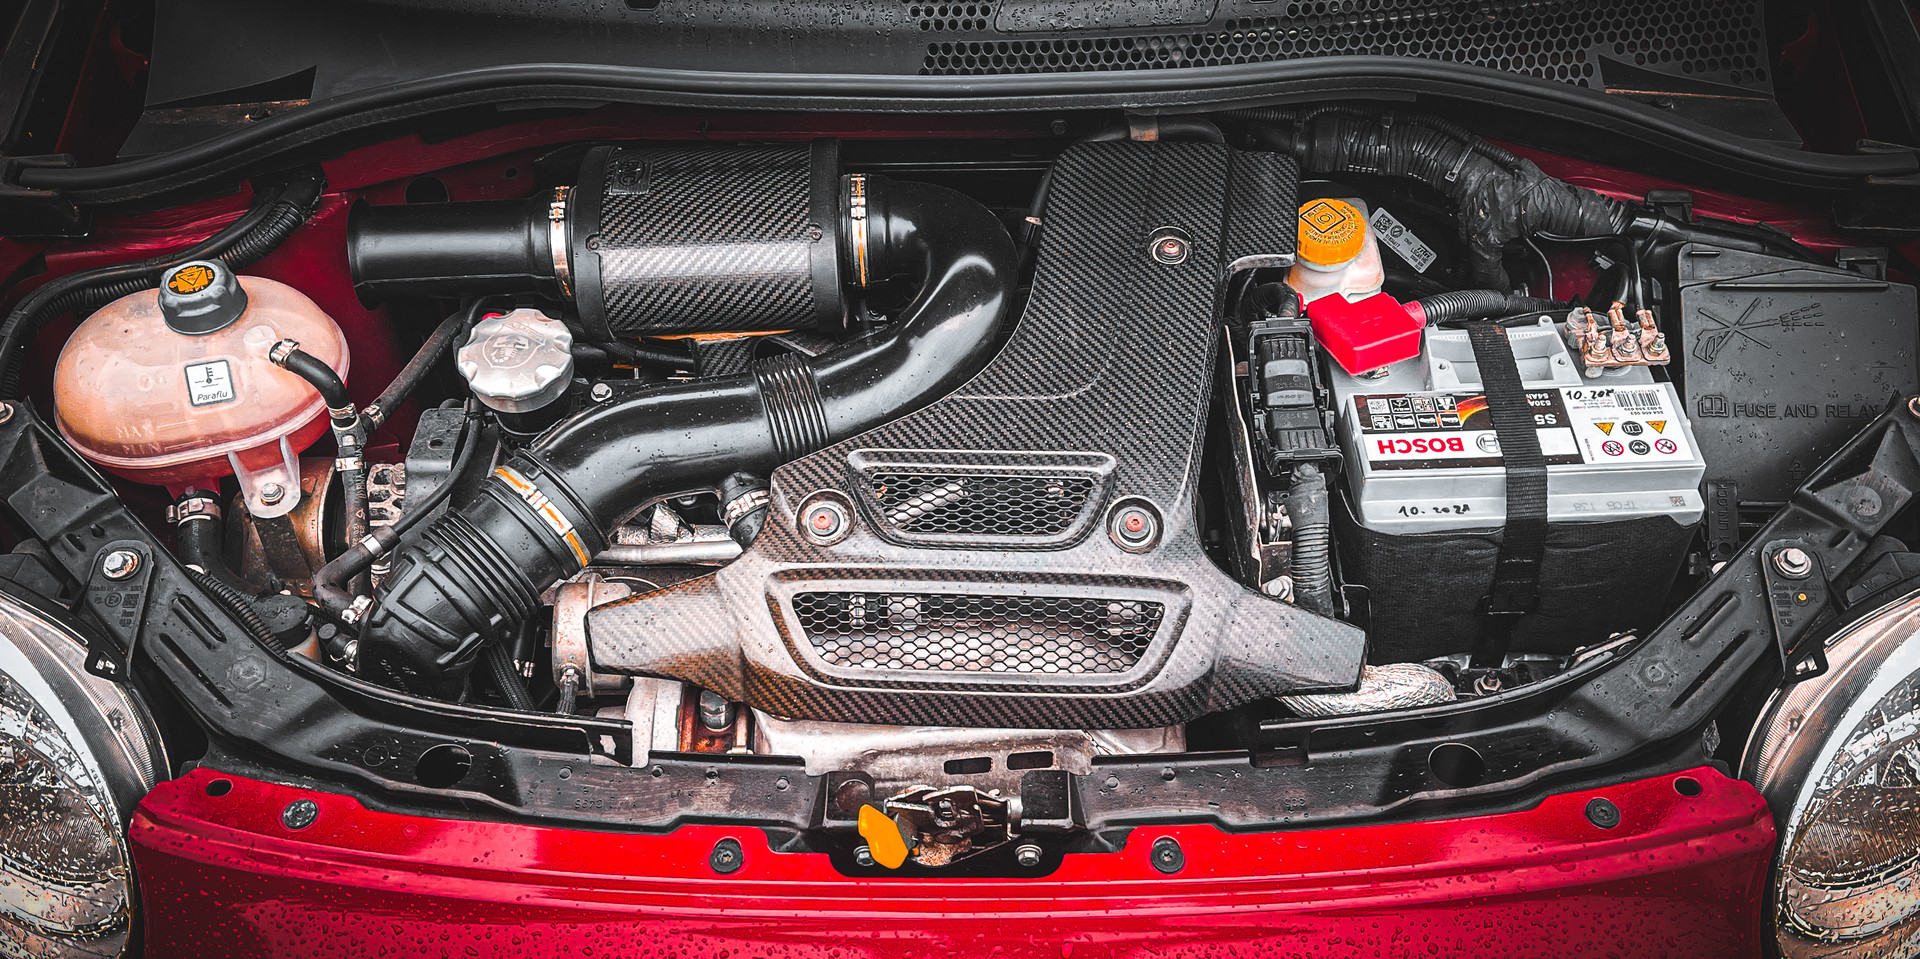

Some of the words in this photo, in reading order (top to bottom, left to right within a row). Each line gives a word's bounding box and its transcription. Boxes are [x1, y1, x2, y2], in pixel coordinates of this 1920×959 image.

[197, 391, 228, 401] Paraflu
[1527, 398, 1551, 406] 530A
[1733, 403, 1777, 418] FUSE
[1784, 403, 1819, 418] AND
[1534, 413, 1557, 425] S5
[116, 423, 154, 439] MAX
[122, 442, 162, 455] MIN
[1377, 437, 1465, 454] BOSCH
[1398, 505, 1425, 517] 10.
[1573, 502, 1595, 511] 138
[1607, 500, 1639, 510] TFCB
[1717, 481, 1729, 531] UNLOCK
